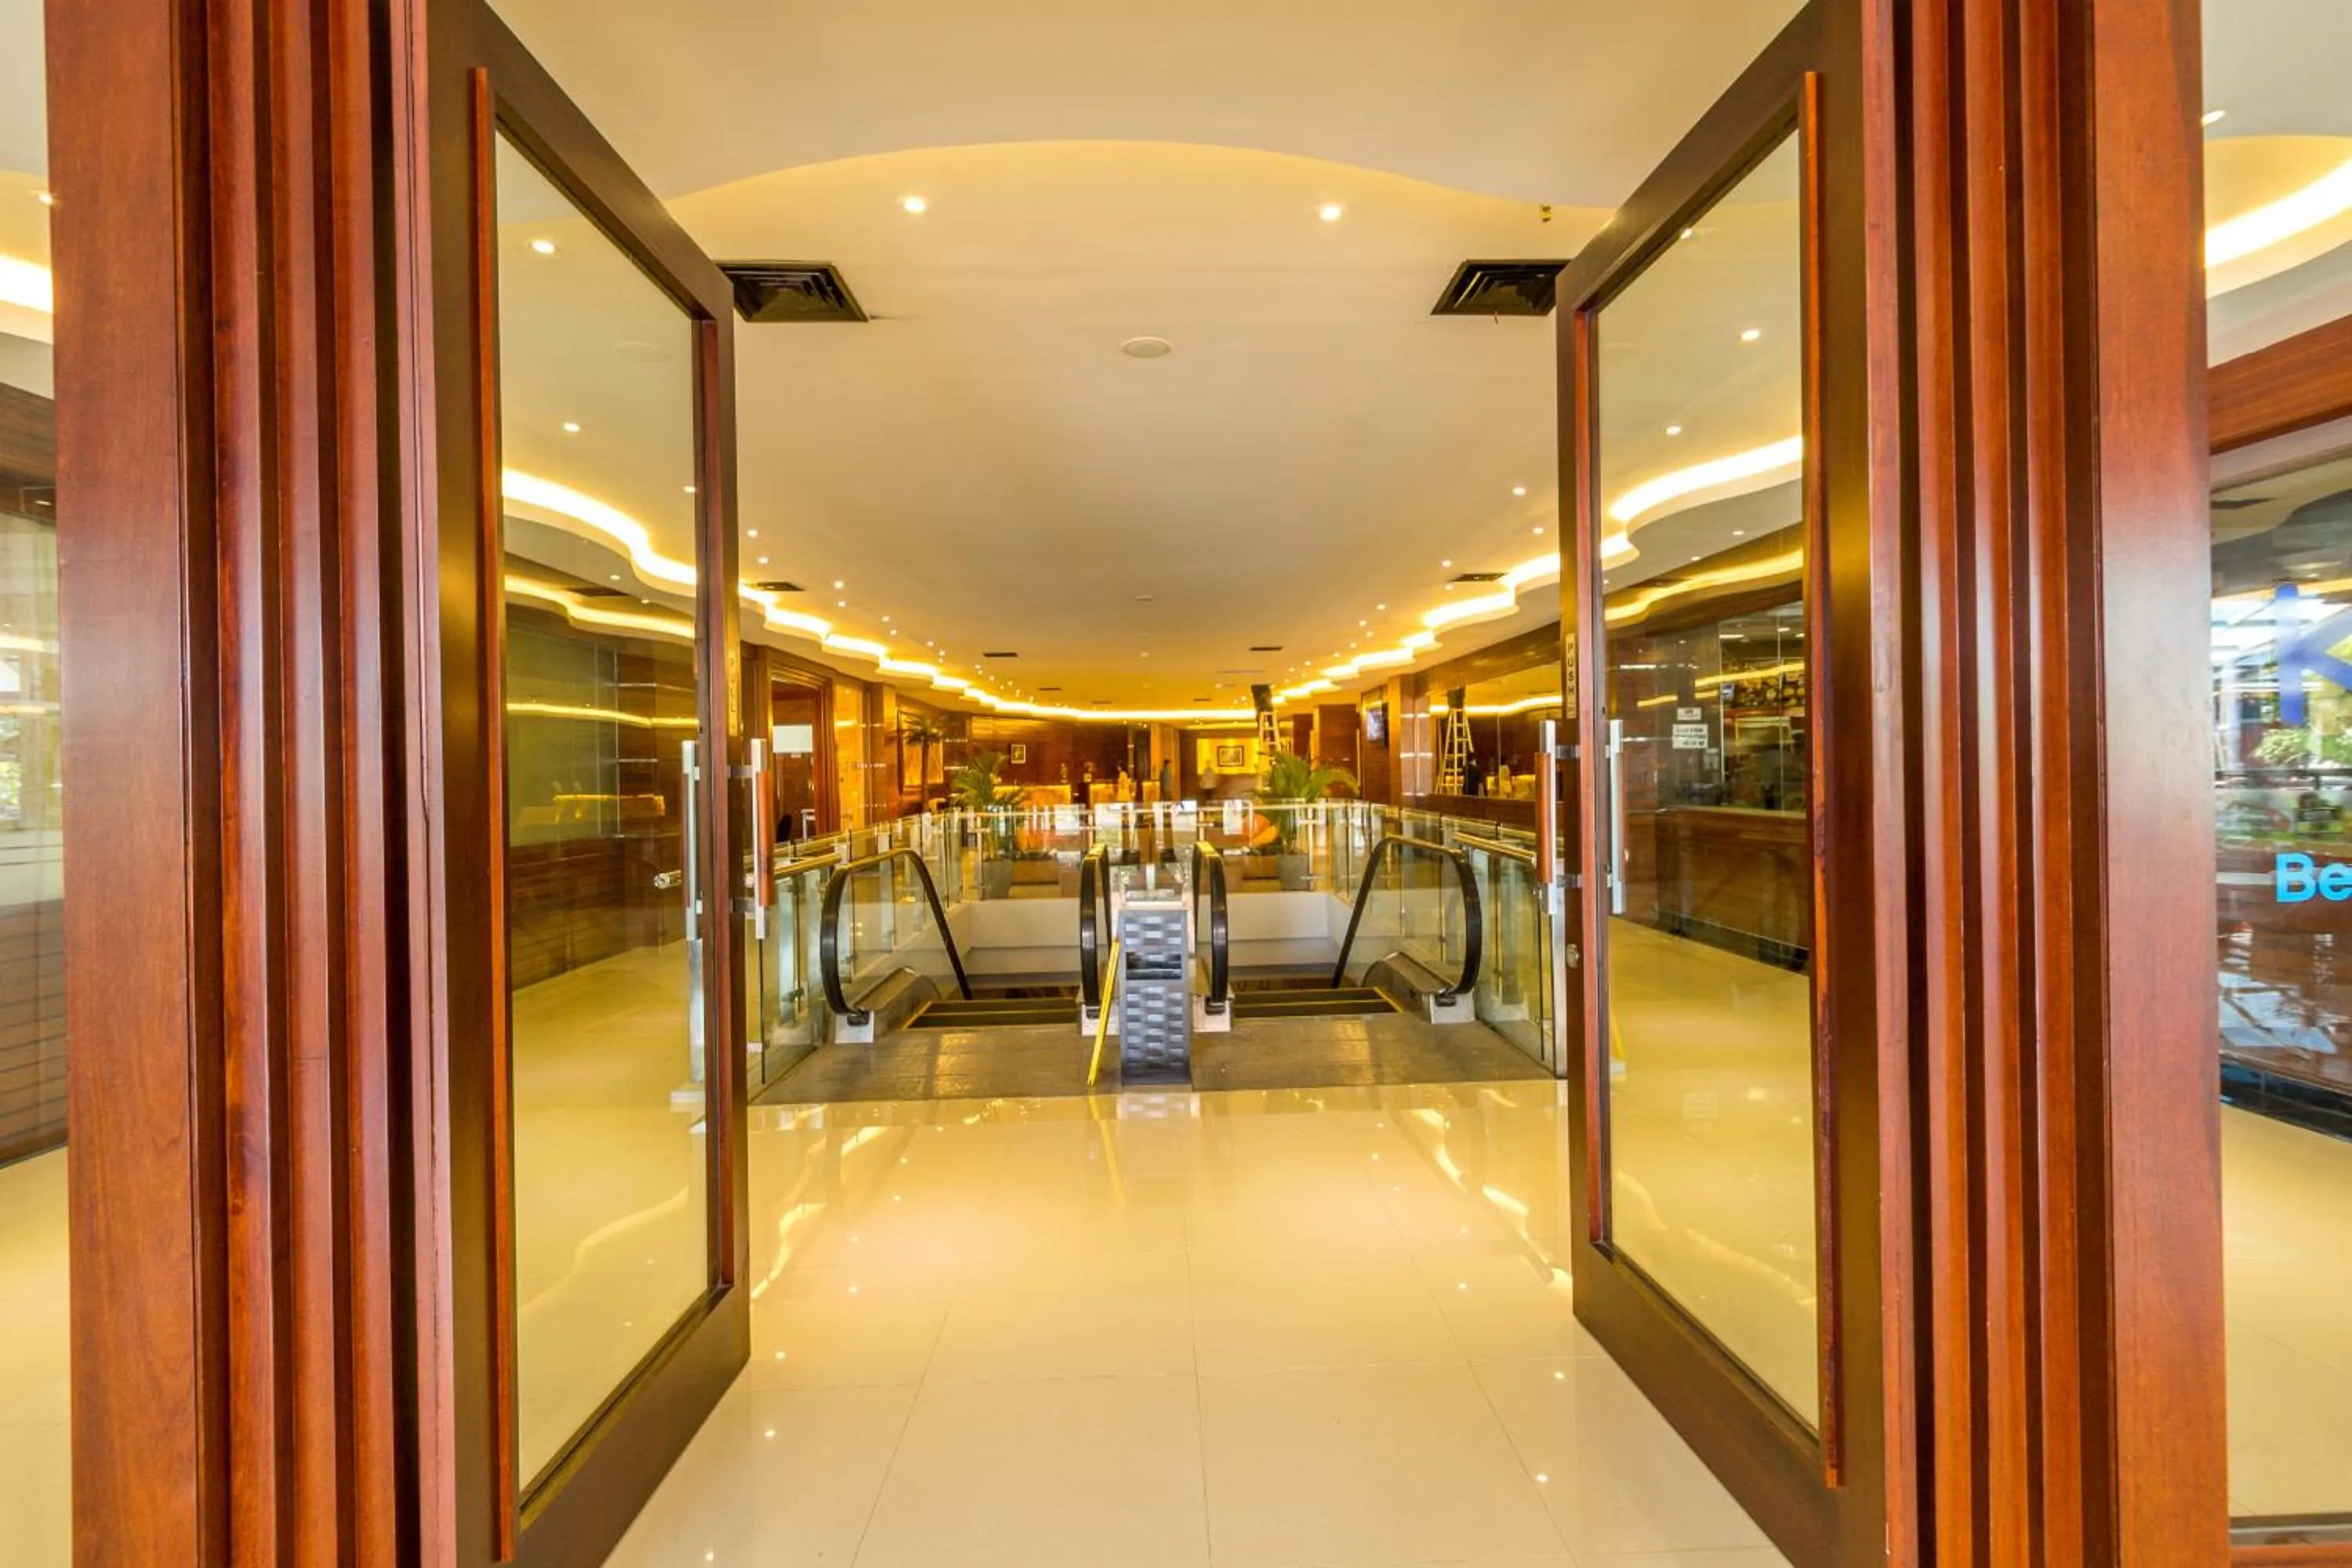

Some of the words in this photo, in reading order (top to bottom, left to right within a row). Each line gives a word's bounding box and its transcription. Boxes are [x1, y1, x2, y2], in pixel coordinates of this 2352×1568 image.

[728, 657, 737, 713] PULL
[1567, 641, 1576, 695] PUSH
[2276, 853, 2352, 902] Be
